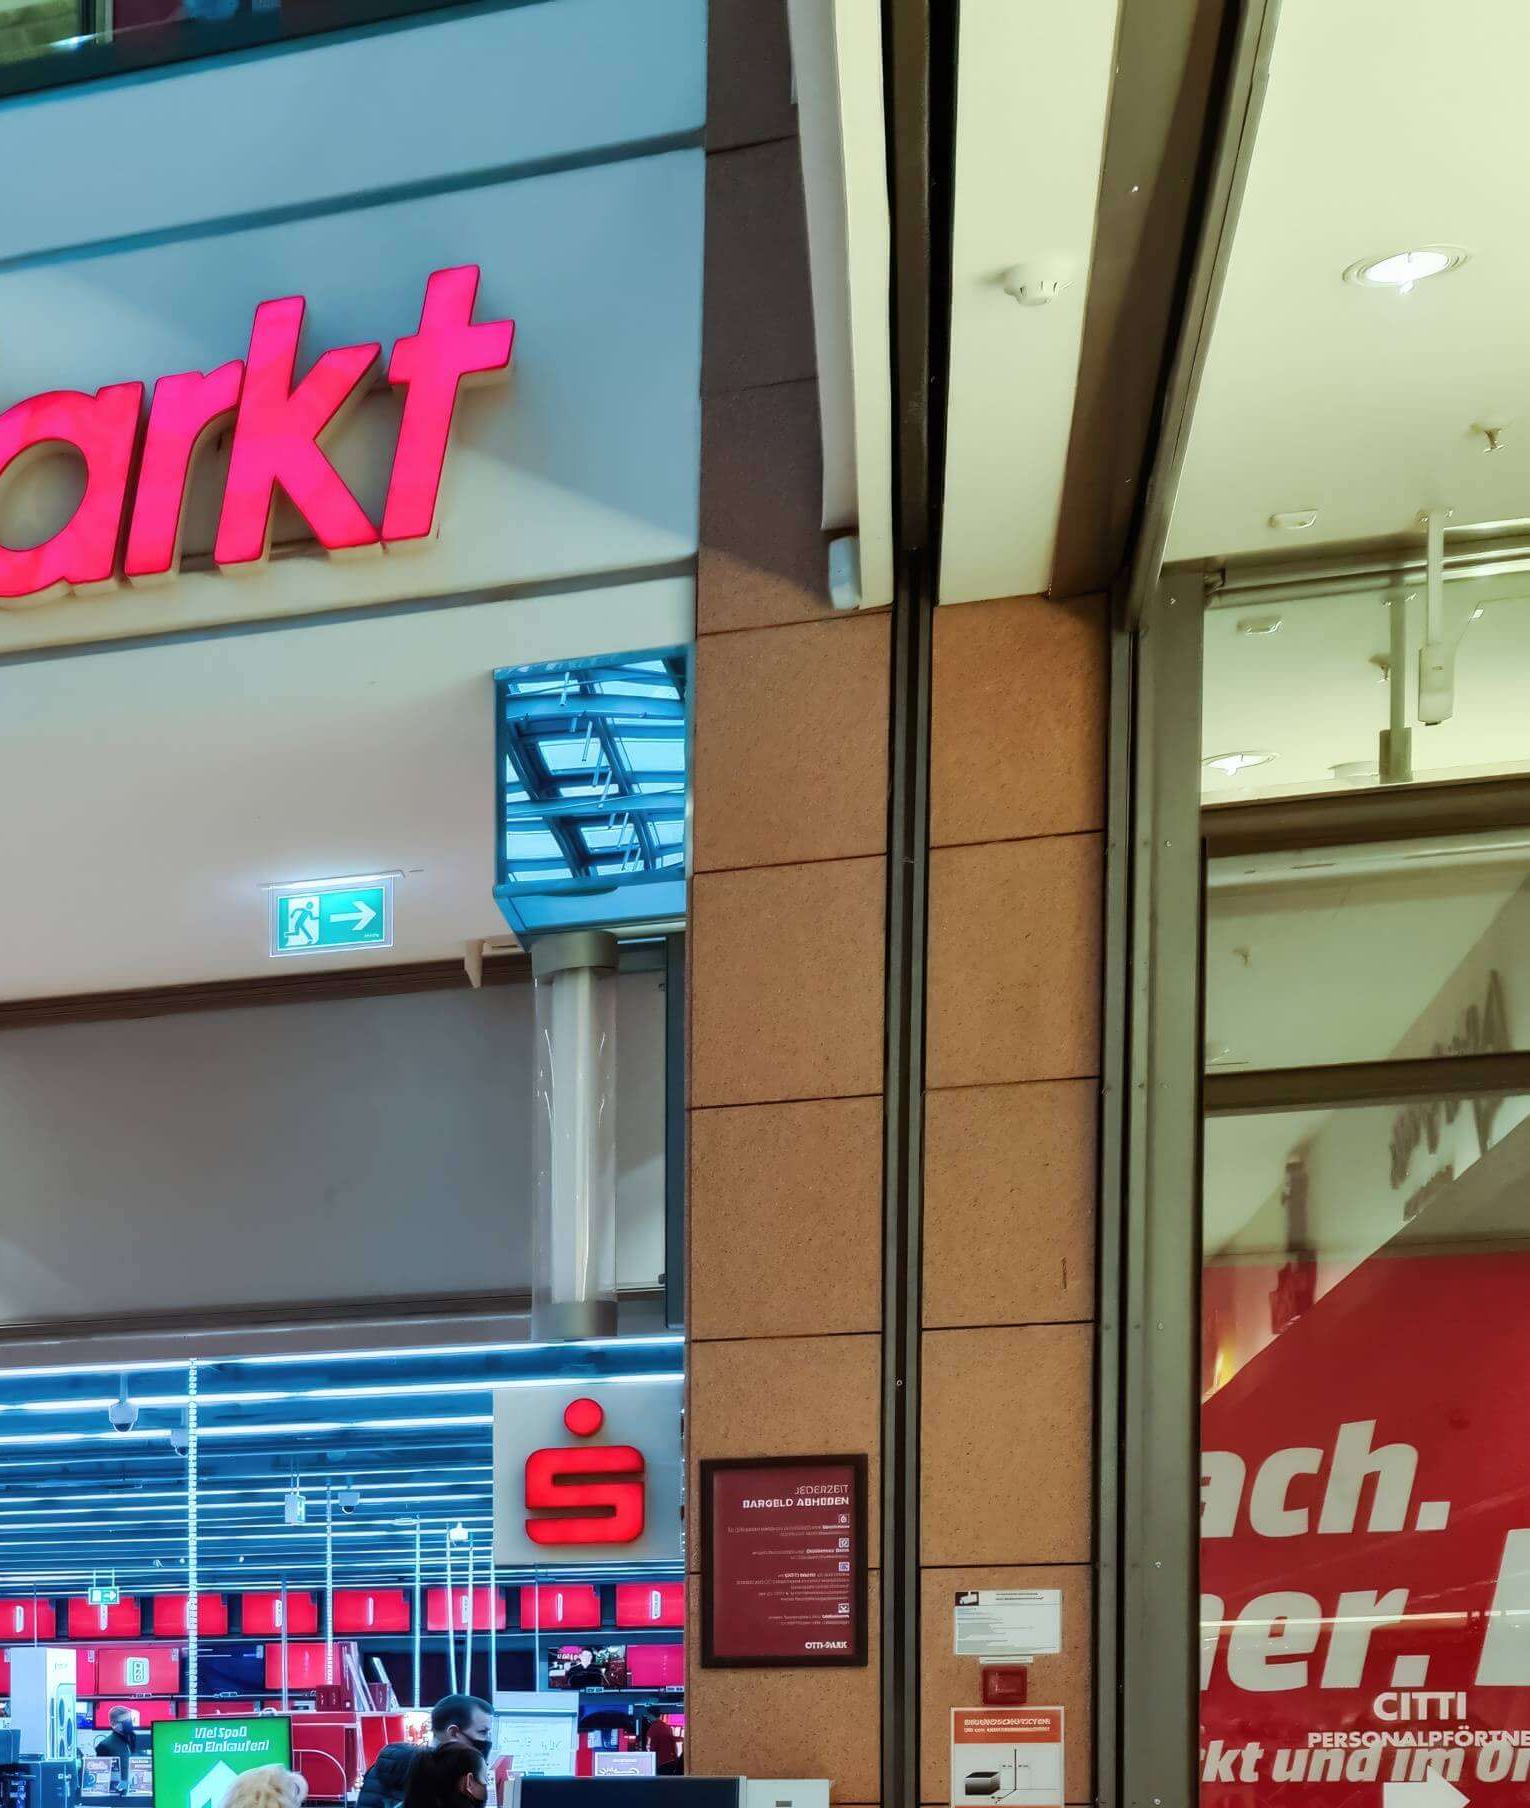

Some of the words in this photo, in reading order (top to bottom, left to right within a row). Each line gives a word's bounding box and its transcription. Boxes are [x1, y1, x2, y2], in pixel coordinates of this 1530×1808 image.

[1372, 1691, 1468, 1722] CITTI
[195, 1727, 217, 1739] Viel
[205, 1739, 270, 1753] Einkaufen!
[1200, 1740, 1265, 1783] kt
[1271, 1740, 1385, 1783] und
[1391, 1740, 1466, 1783] im
